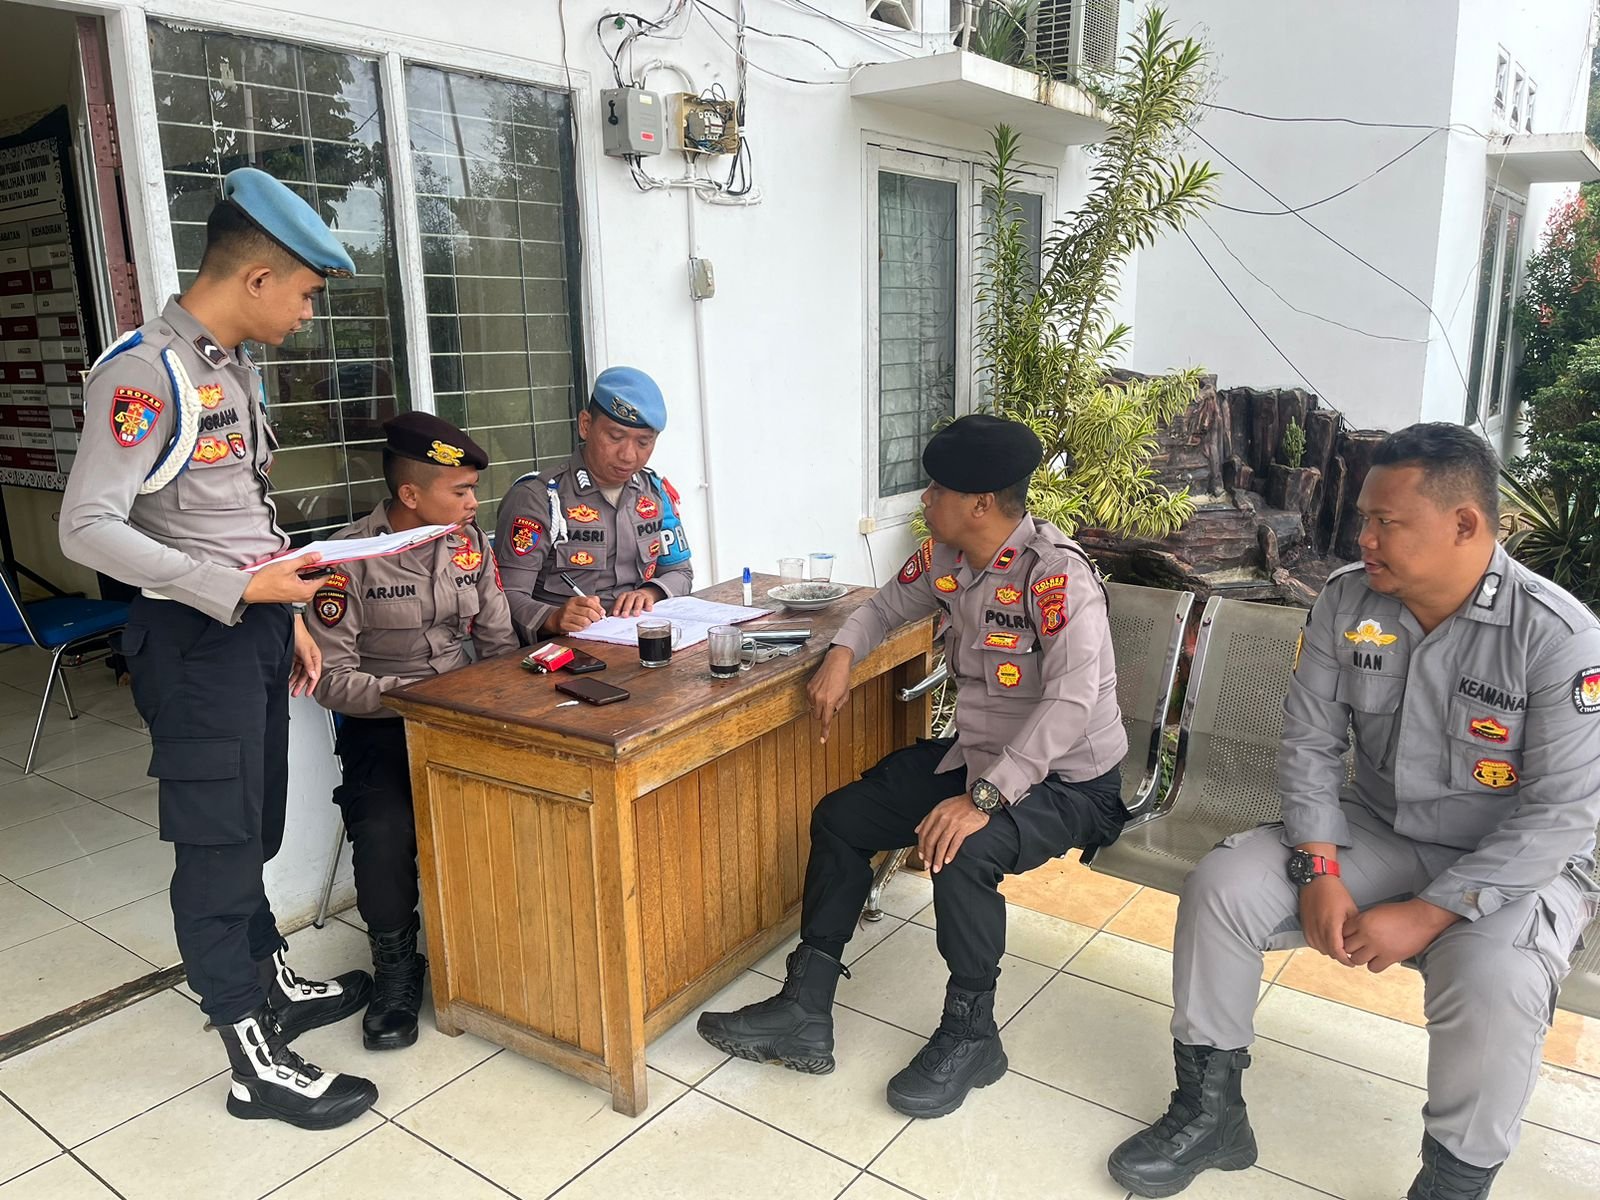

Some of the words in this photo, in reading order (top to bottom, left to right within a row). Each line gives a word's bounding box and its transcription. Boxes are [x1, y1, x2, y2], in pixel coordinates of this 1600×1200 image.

[26, 170, 47, 185] UMUM
[366, 584, 416, 600] ARJUN
[985, 609, 1030, 629] POLRI
